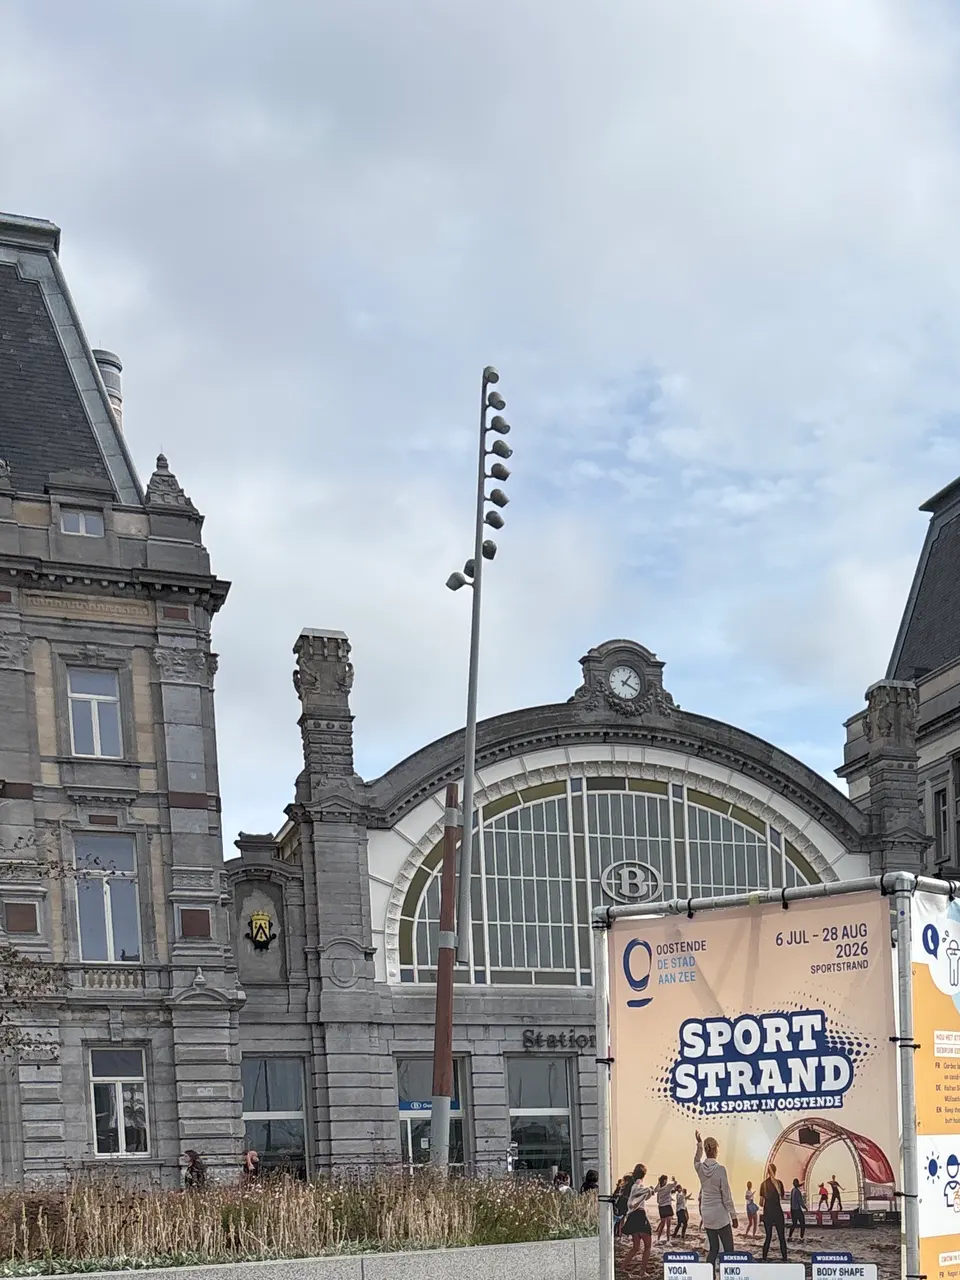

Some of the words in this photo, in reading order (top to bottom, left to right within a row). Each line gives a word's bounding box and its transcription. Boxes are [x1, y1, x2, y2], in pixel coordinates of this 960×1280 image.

[776, 933, 783, 946] 6
[786, 931, 809, 945] JUL
[822, 927, 838, 942] 28
[841, 923, 868, 940] AUG
[656, 940, 706, 955] OOSTENDE
[836, 942, 868, 958] 2026
[658, 959, 668, 970] DE
[671, 956, 695, 968] STAD
[811, 960, 868, 974] SPORTSTRAND
[658, 973, 676, 984] AAN
[678, 971, 696, 982] ZEE
[682, 1014, 822, 1058] SPORT
[675, 1055, 850, 1099] STRAND
[706, 1101, 720, 1112] IK
[722, 1099, 759, 1111] SPORT
[761, 1099, 775, 1109] IN
[778, 1096, 841, 1109] OOSTENDE
[839, 1268, 864, 1276] SHAPE
